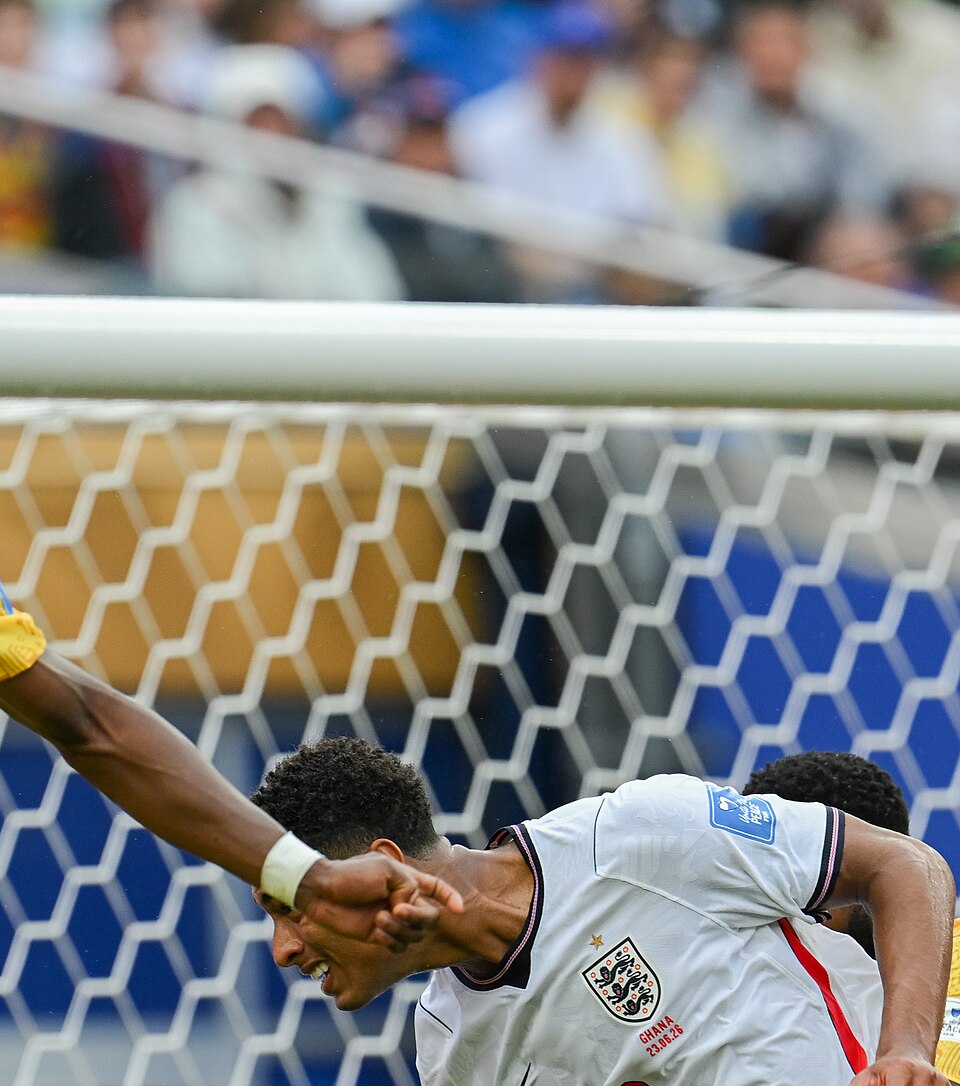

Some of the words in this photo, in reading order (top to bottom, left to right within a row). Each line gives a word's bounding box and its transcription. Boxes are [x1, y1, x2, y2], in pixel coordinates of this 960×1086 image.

[749, 801, 763, 826] PEACE
[639, 1015, 674, 1044] GHANA
[646, 1023, 684, 1057] 23.06.26
